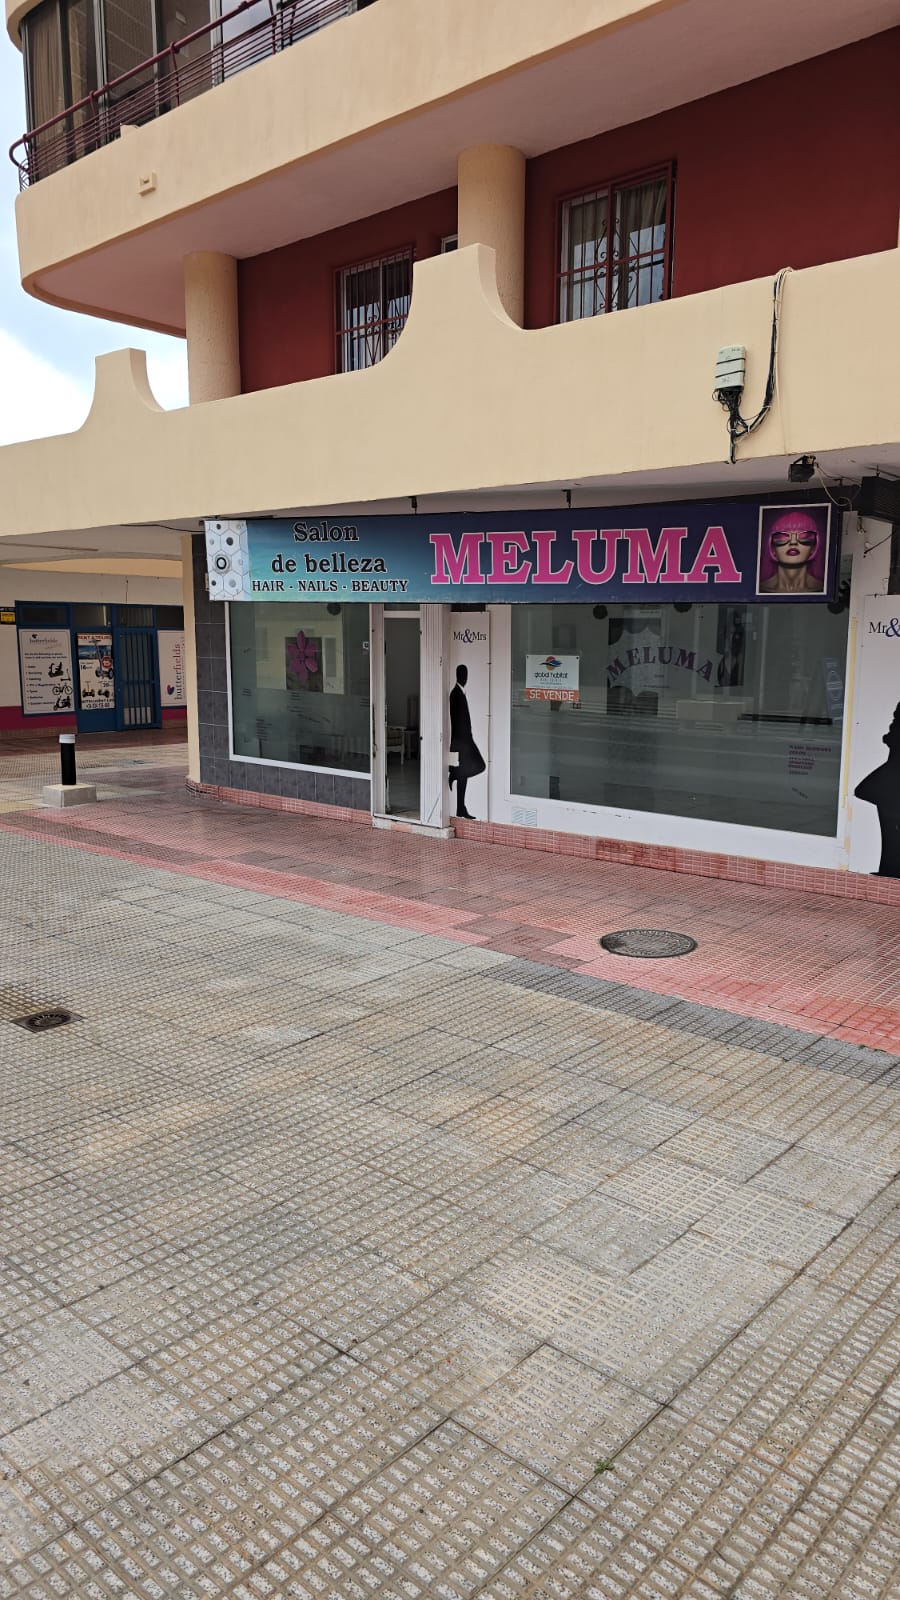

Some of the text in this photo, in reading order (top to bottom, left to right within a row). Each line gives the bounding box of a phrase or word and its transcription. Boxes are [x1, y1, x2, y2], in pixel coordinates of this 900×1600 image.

[293, 520, 360, 542] Salon
[271, 552, 388, 574] de belleza
[429, 526, 742, 585] MELUMA
[252, 580, 285, 592] HAIR
[297, 580, 338, 592] NAILS
[352, 579, 408, 593] BEAUTY
[606, 646, 714, 683] MELUMA
[529, 689, 575, 701] SE VENDE
